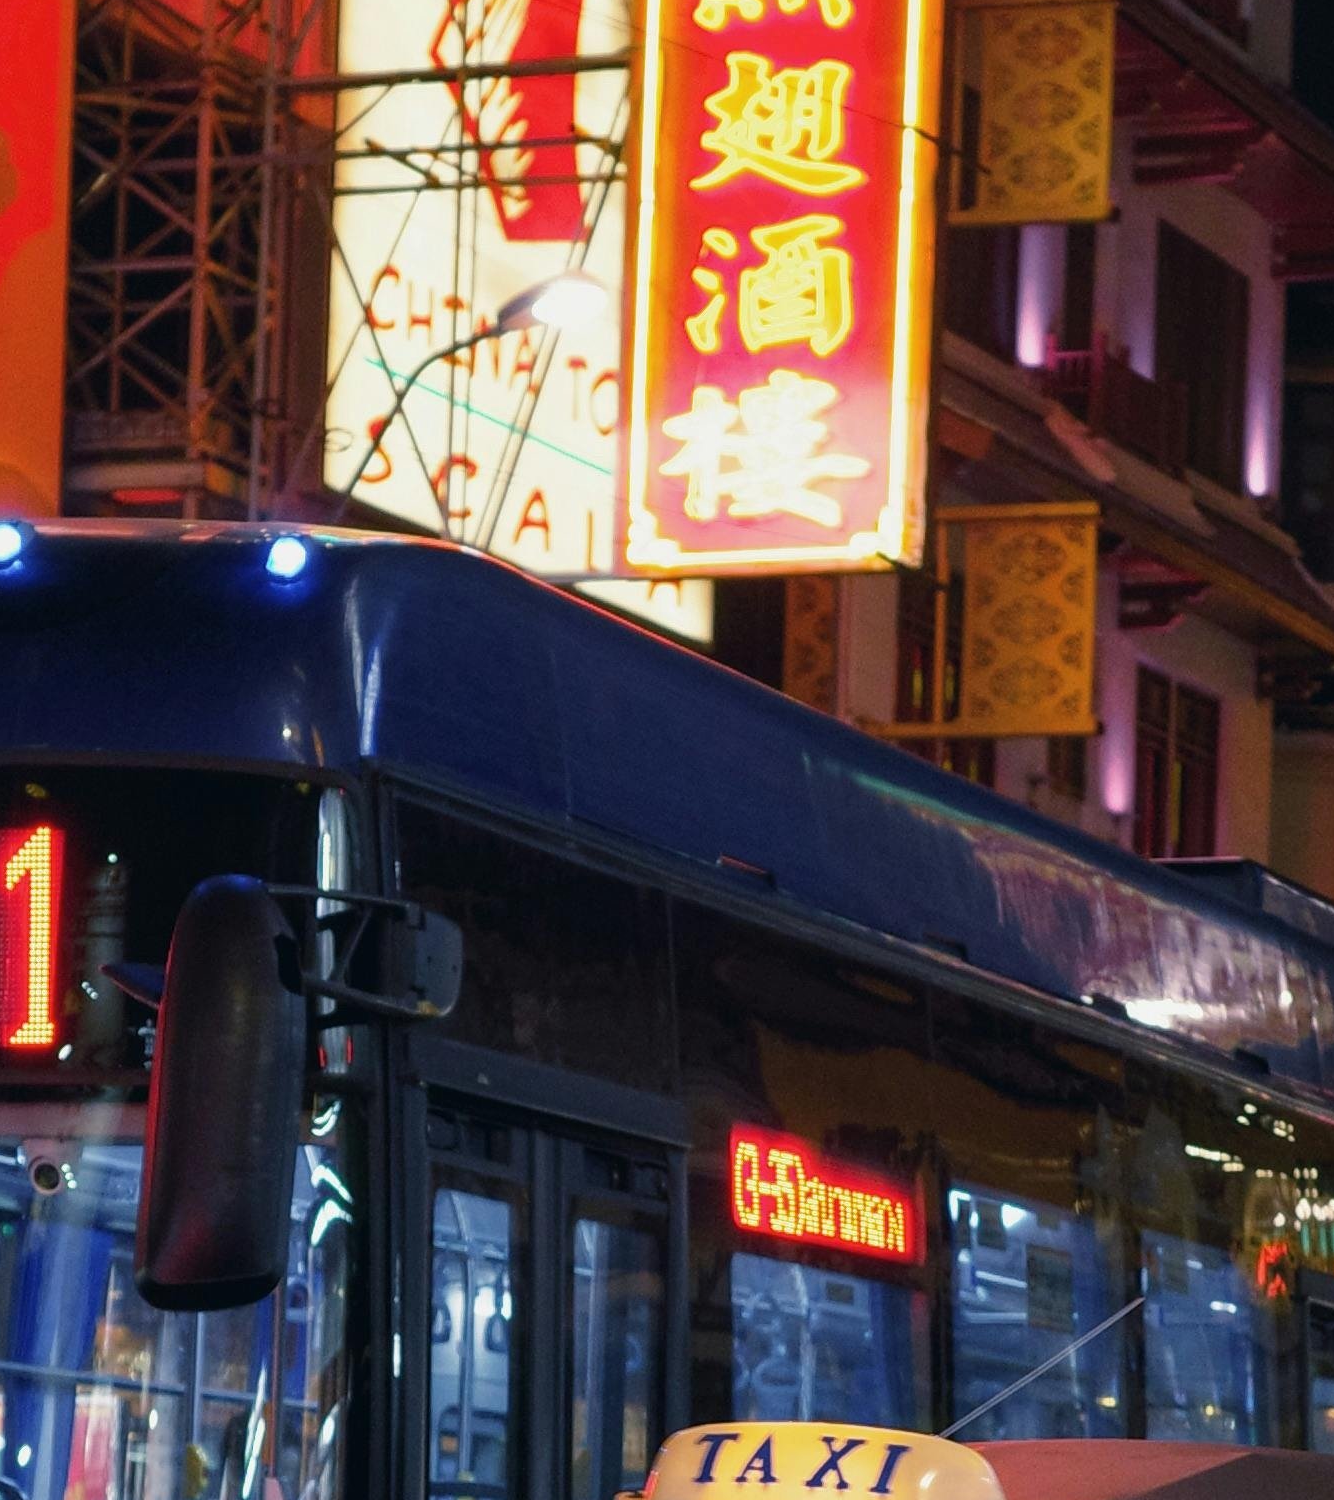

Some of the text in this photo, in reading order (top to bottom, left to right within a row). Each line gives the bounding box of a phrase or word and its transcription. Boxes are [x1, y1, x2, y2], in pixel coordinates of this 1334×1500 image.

[366, 264, 540, 397] CHINA
[5, 826, 55, 1045] 1
[694, 1432, 912, 1494] TAXI
